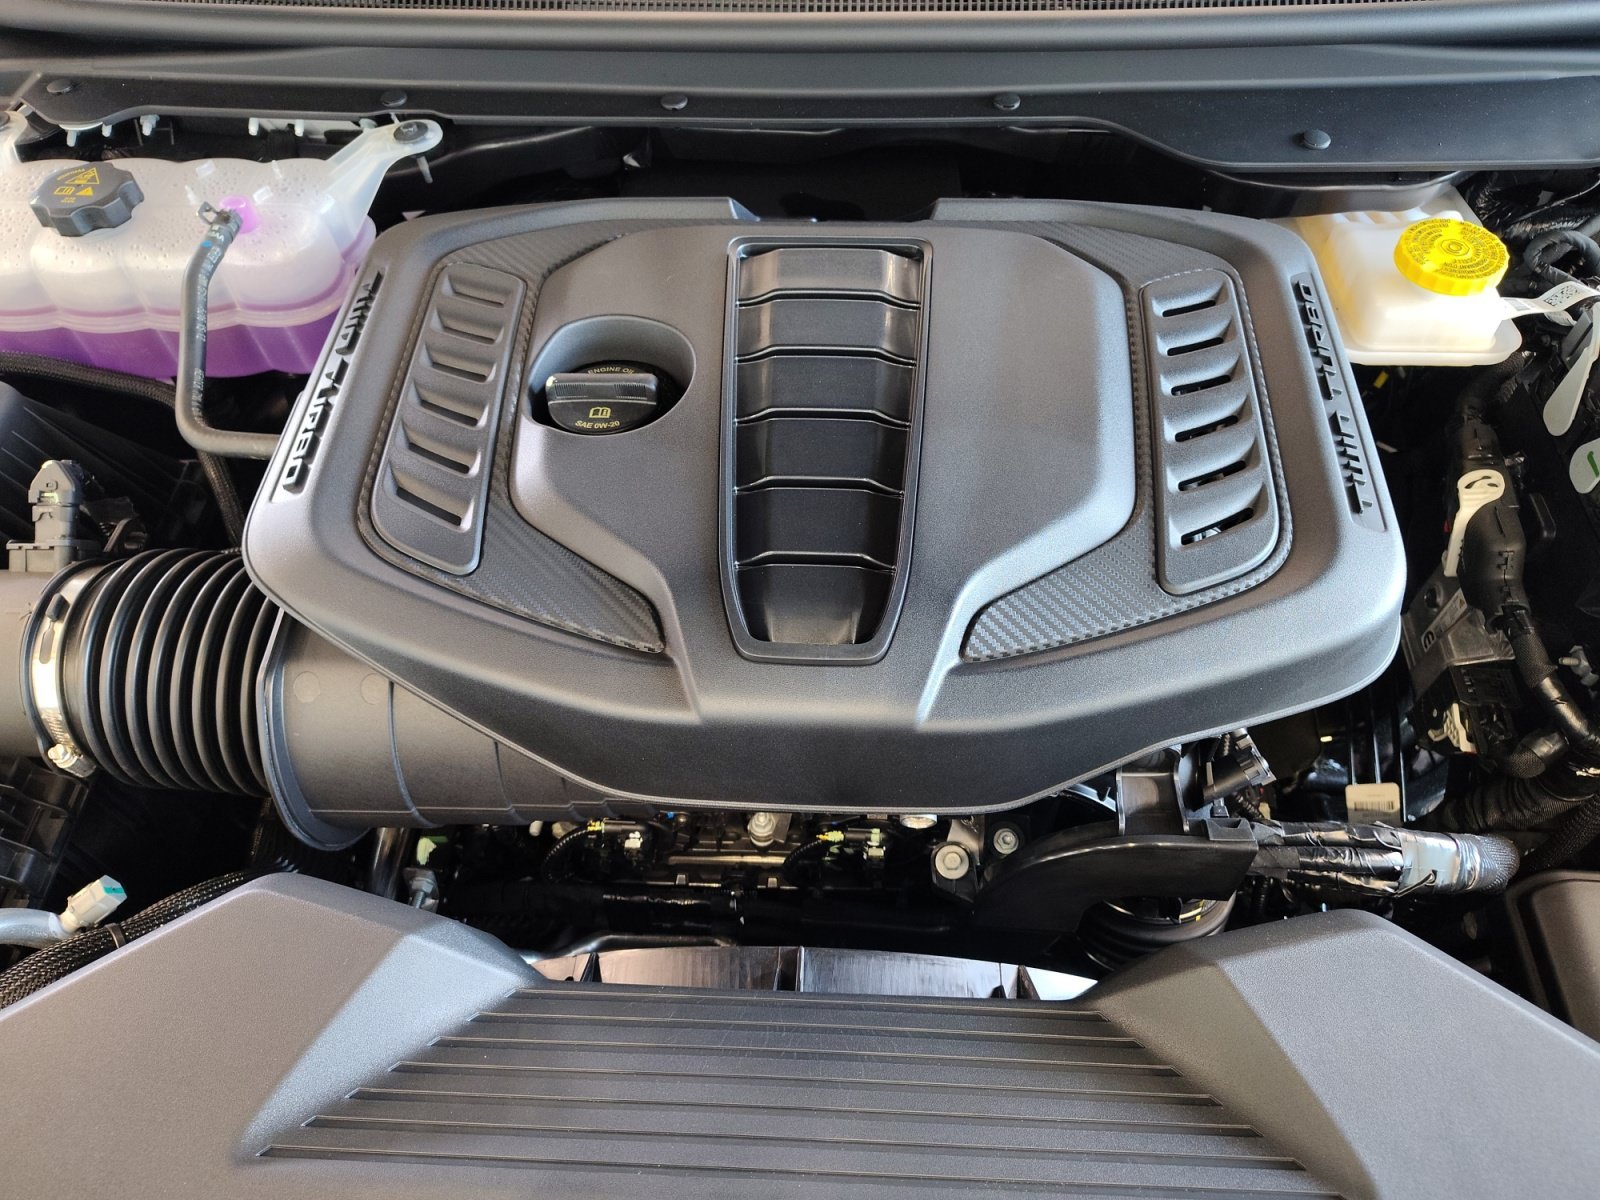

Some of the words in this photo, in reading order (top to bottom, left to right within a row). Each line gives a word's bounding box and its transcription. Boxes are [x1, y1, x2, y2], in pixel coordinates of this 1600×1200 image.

[336, 271, 384, 356] TWIN
[1293, 279, 1342, 400] TURBO
[587, 366, 621, 375] ENGINE
[622, 367, 635, 375] OIL
[282, 358, 348, 494] TURBO
[575, 420, 593, 429] SAE
[594, 421, 619, 429] 0W-20
[1327, 411, 1372, 515] TWIN
